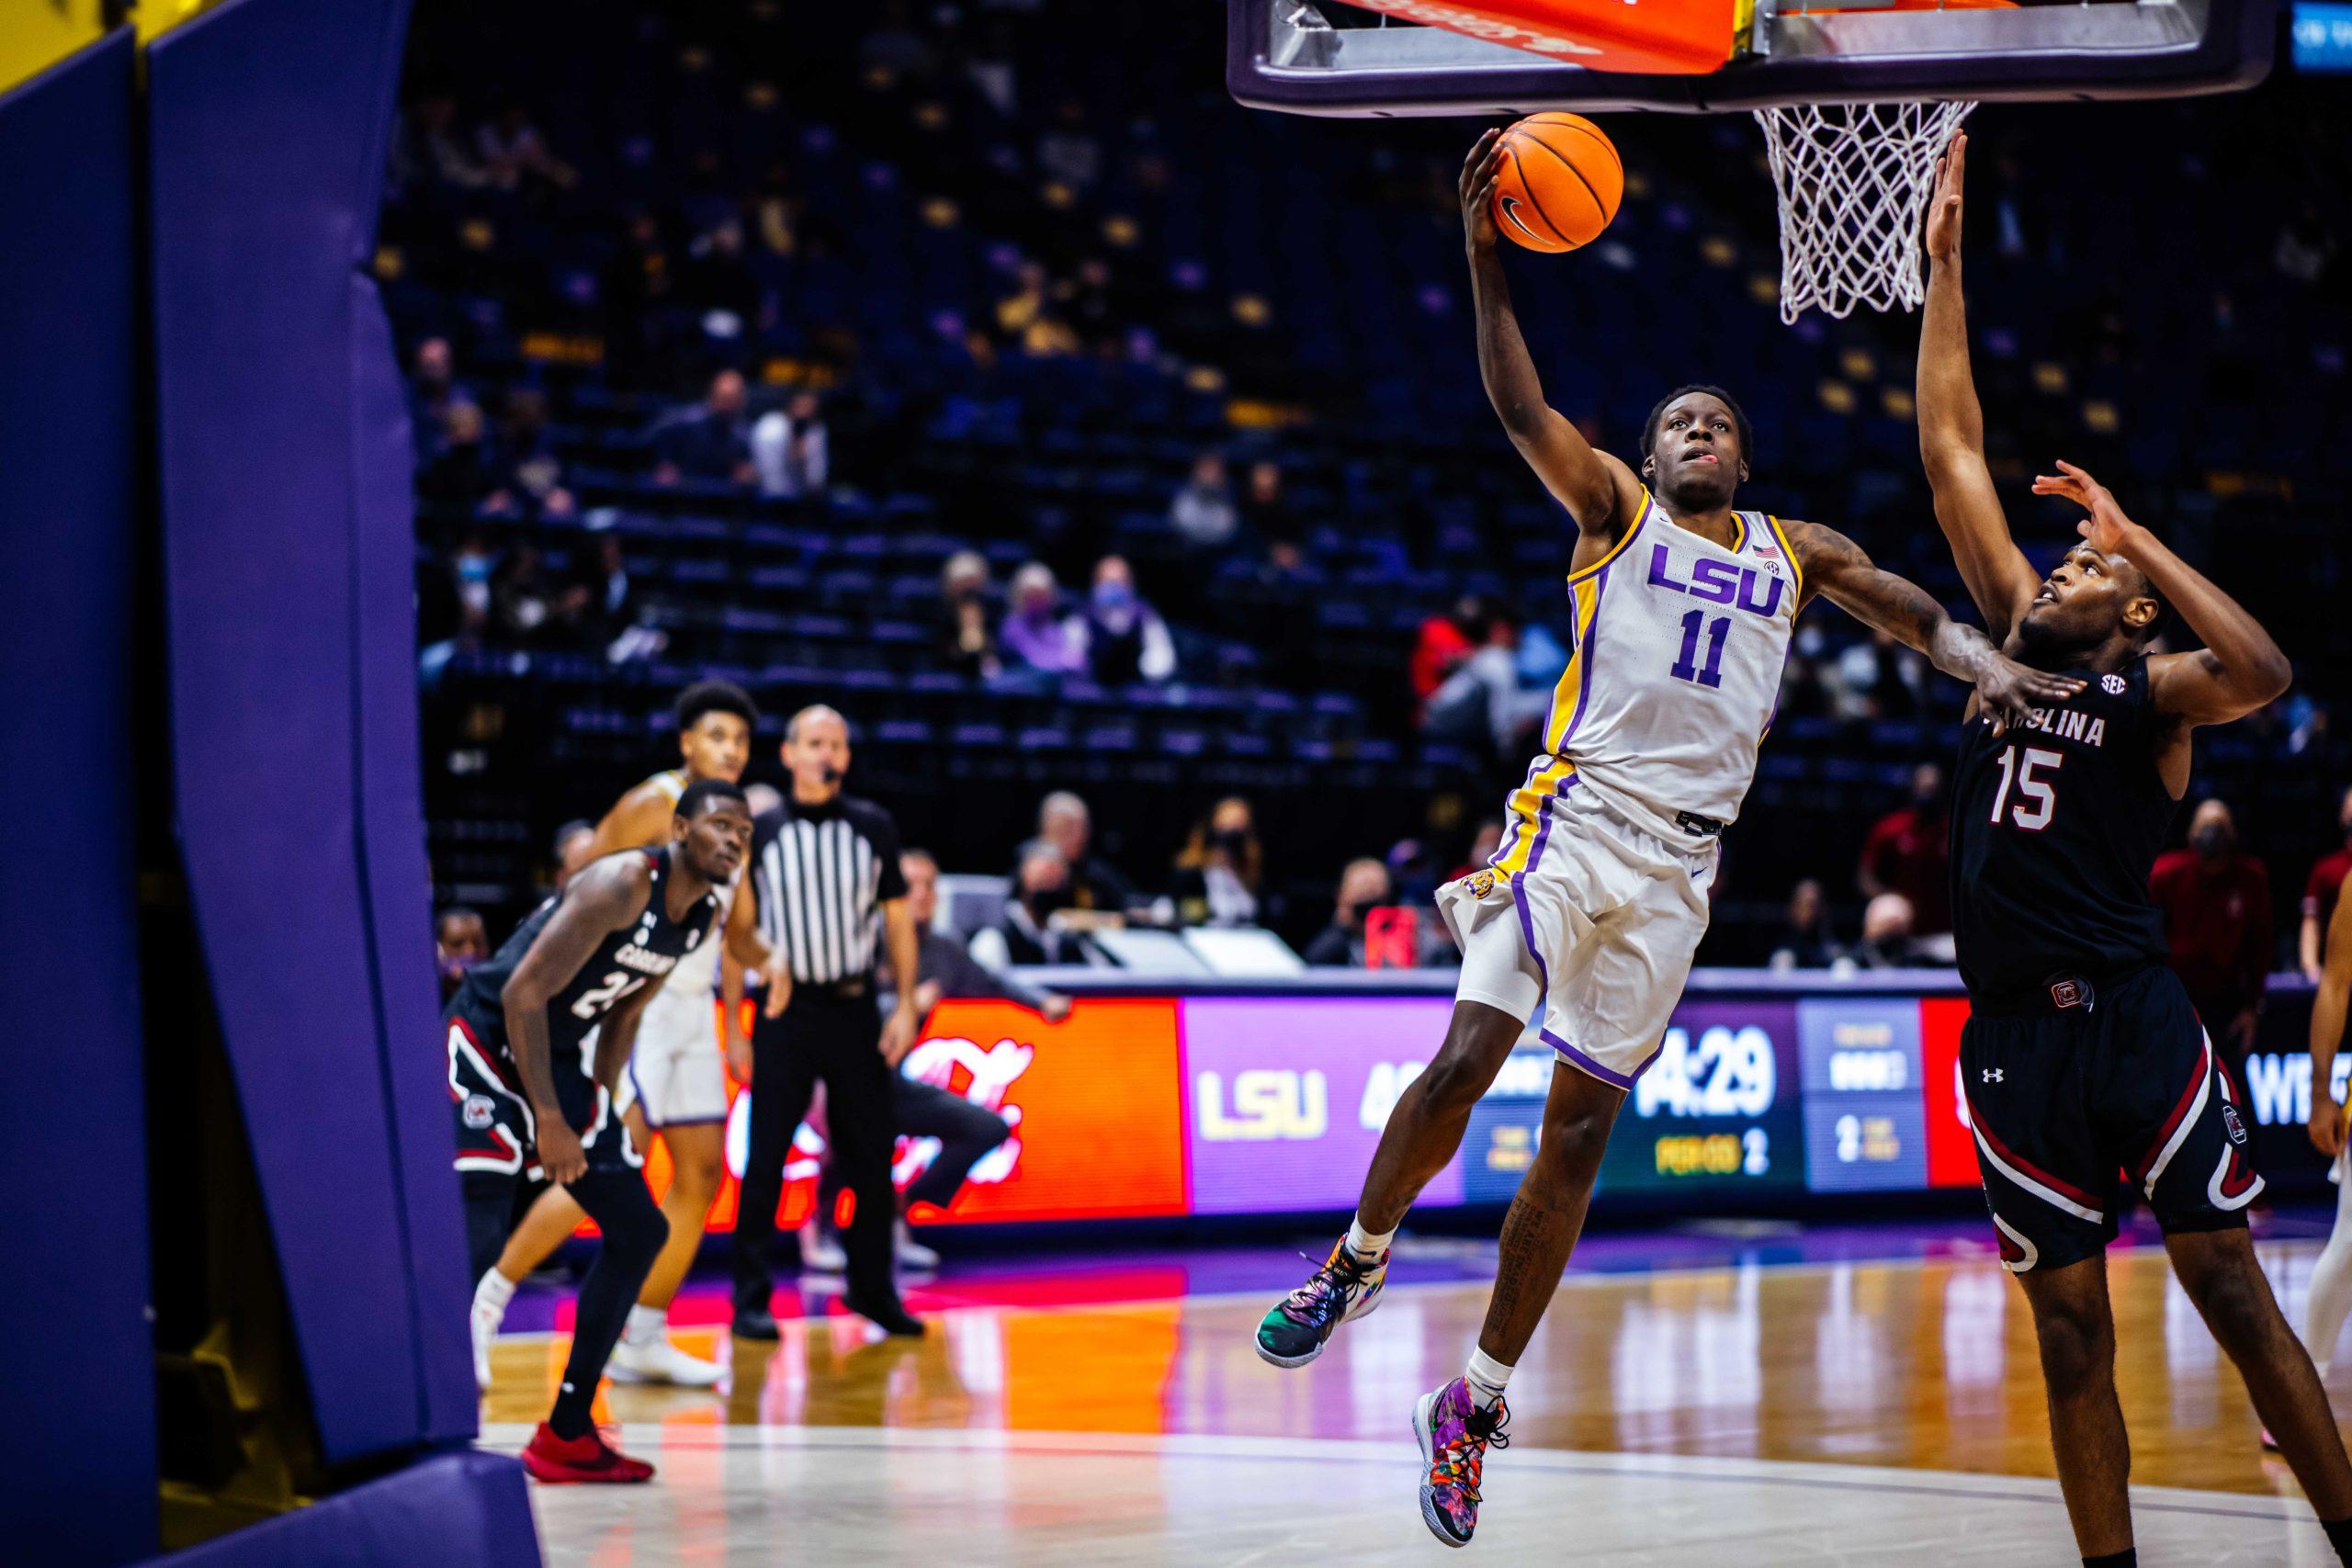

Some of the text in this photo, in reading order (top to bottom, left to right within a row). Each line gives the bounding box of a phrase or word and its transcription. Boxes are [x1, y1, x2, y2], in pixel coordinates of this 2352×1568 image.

[1647, 544, 1785, 617] LSU
[1670, 609, 1732, 689] 11
[2100, 672, 2127, 696] SEC
[1983, 707, 2106, 748] OLINA
[1990, 744, 2064, 831] 15
[1196, 1069, 1328, 1141] LSU
